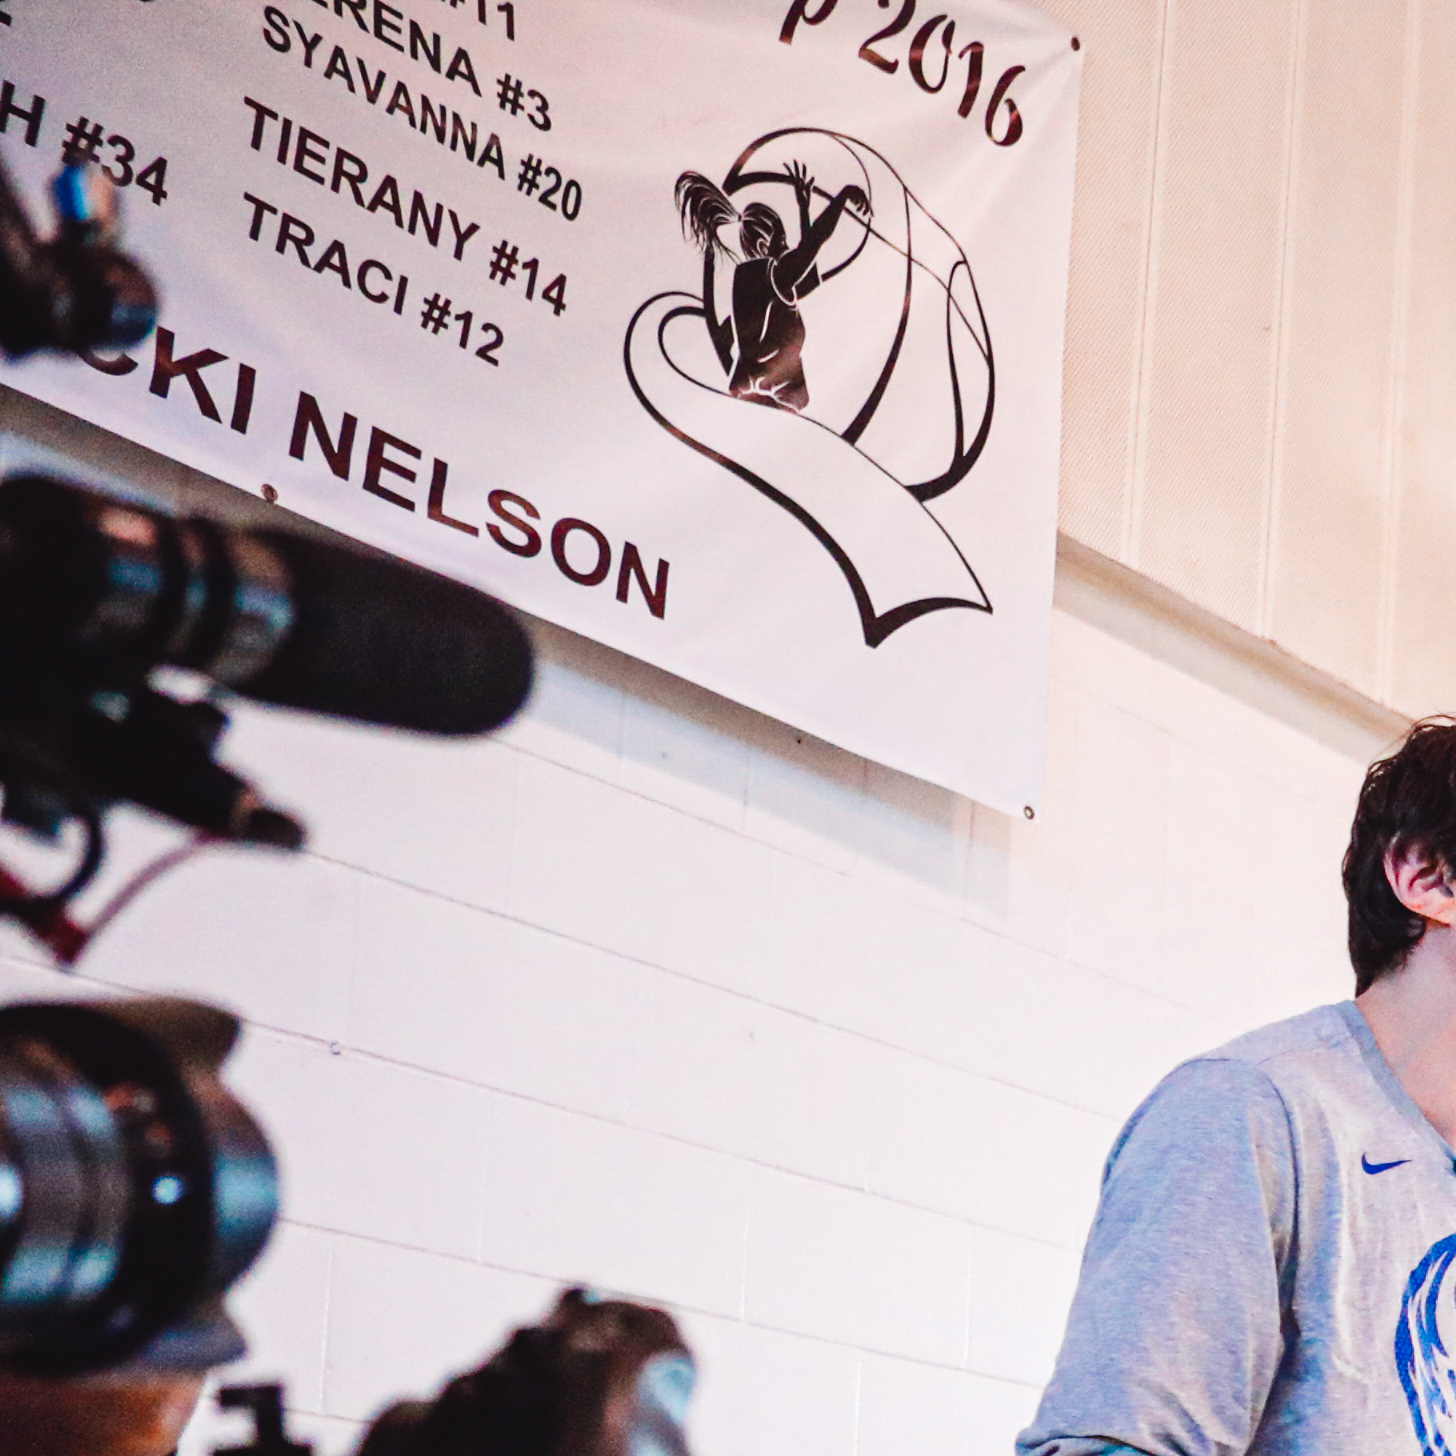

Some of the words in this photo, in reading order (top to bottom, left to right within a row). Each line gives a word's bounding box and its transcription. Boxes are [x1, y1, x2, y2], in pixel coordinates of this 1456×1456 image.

[262, 5, 507, 181] SYAVANNA
[517, 153, 584, 221] #20
[312, 0, 482, 98] RENA
[496, 73, 552, 132] #3
[858, 0, 1026, 147] 2016
[61, 116, 169, 207] #34
[243, 95, 481, 262] TIERANY
[489, 239, 569, 317] #14
[242, 191, 410, 316] TRACI
[420, 292, 506, 367] #12
[288, 390, 670, 621] NELSON
